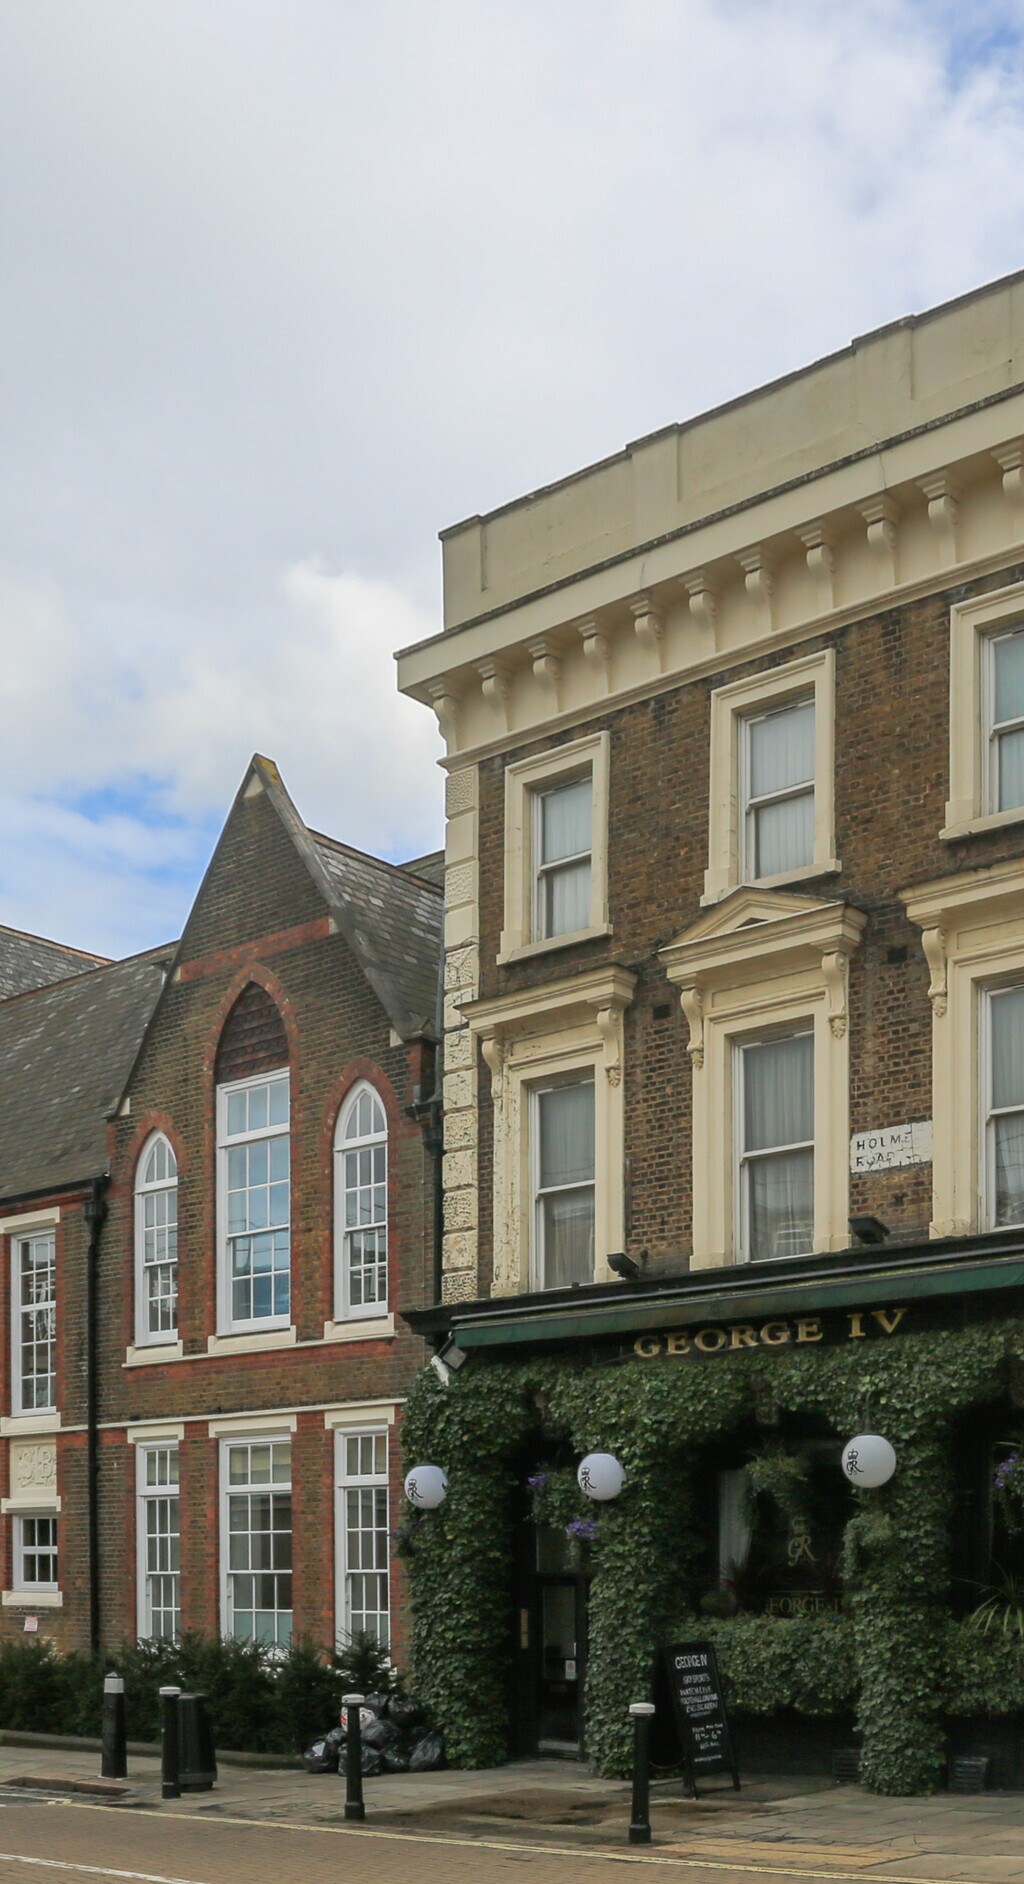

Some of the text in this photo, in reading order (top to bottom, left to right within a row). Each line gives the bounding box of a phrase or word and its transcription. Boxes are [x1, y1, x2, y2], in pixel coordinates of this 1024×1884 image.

[633, 1308, 908, 1358] GEORGE IV
[769, 1596, 825, 1613] EORGE
